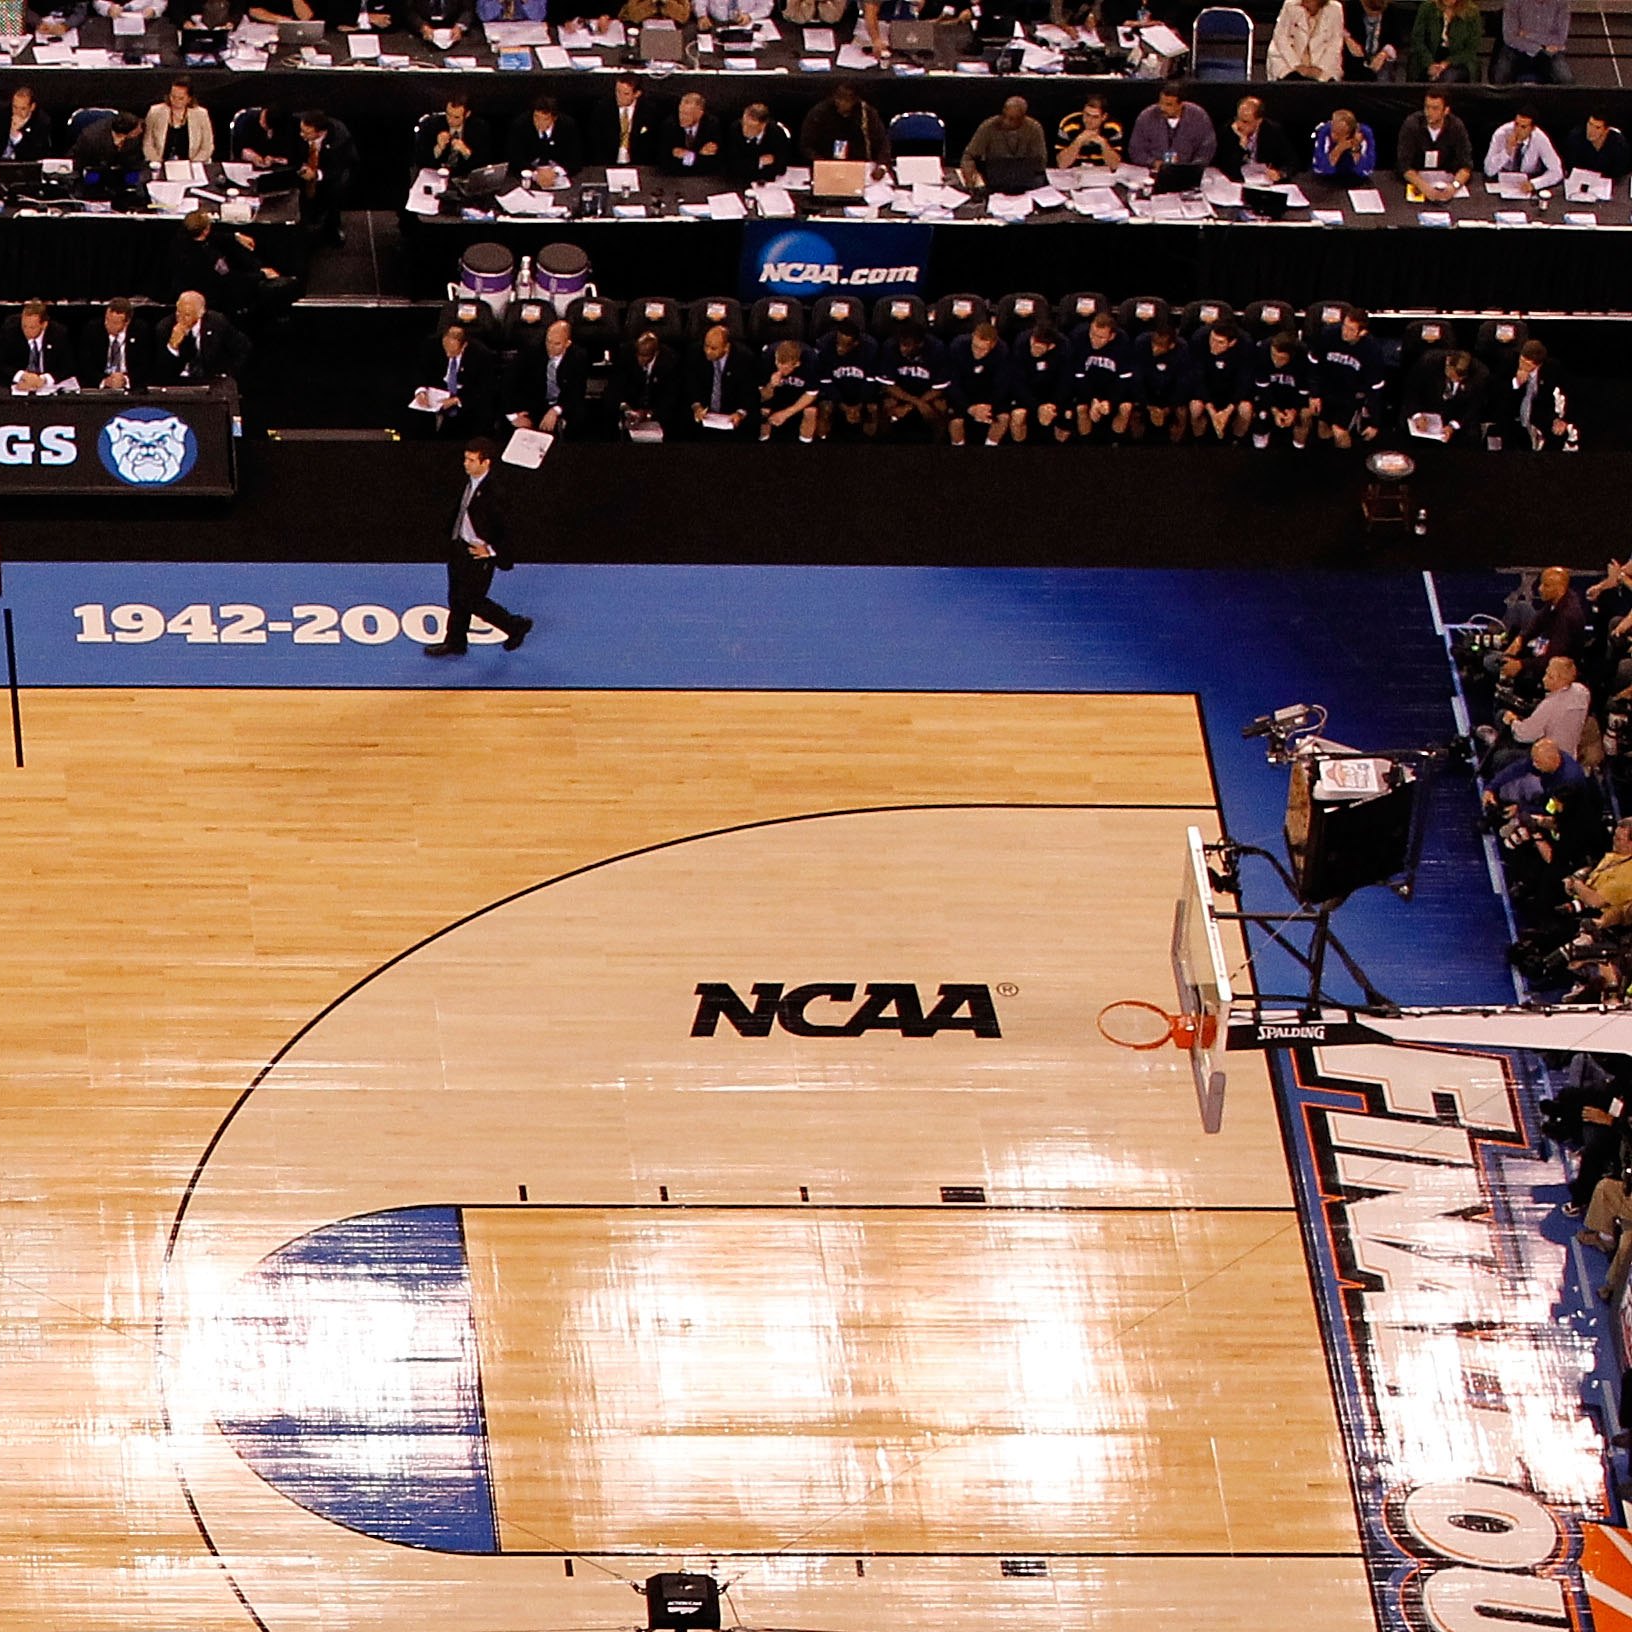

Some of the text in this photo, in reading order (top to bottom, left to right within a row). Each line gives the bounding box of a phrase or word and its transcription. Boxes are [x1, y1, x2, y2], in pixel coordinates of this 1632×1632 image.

[759, 262, 919, 285] NCAA.com
[690, 982, 1003, 1039] NCAA
[1256, 1025, 1326, 1041] SPALDING
